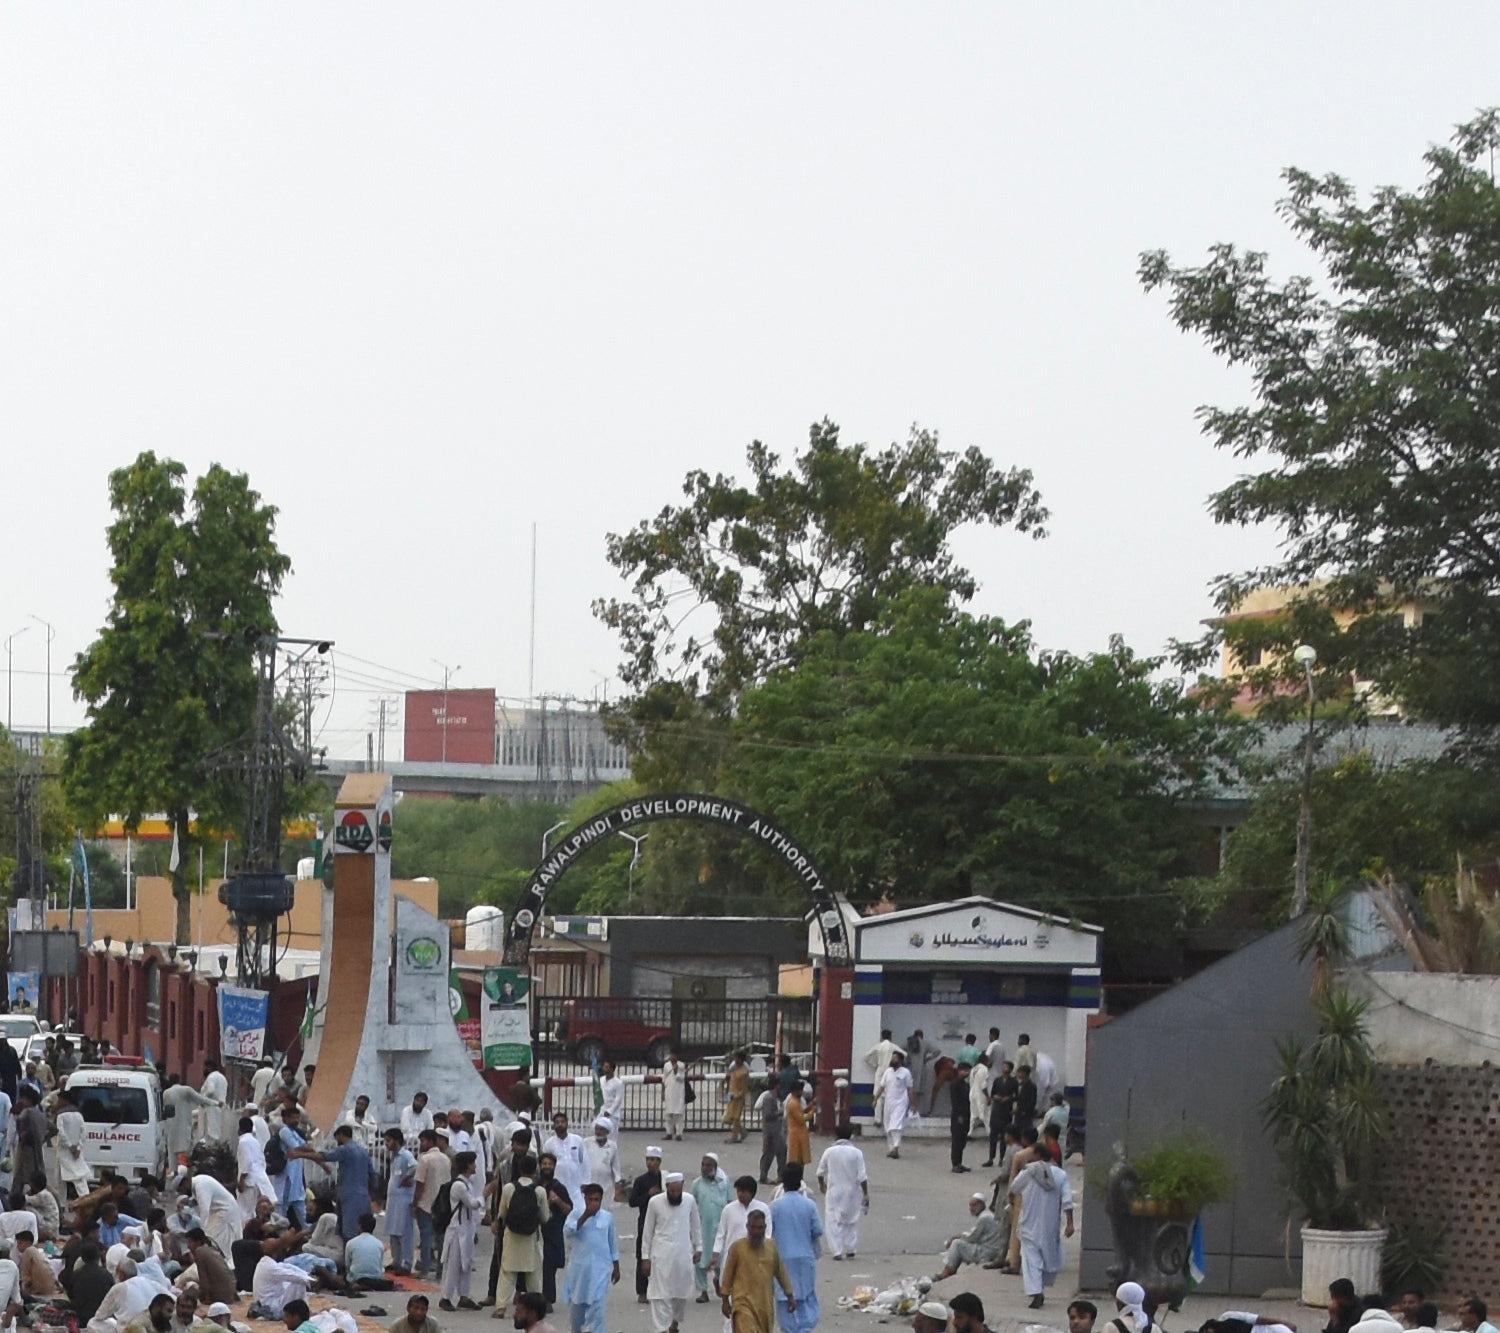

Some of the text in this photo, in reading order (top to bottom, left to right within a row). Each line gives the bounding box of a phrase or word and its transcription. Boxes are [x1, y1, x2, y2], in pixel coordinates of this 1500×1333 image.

[336, 826, 374, 840] RDA
[531, 799, 824, 896] RAWALPINDI DEVELOPMENT AUTHORITY
[88, 1131, 141, 1142] BULANCE
